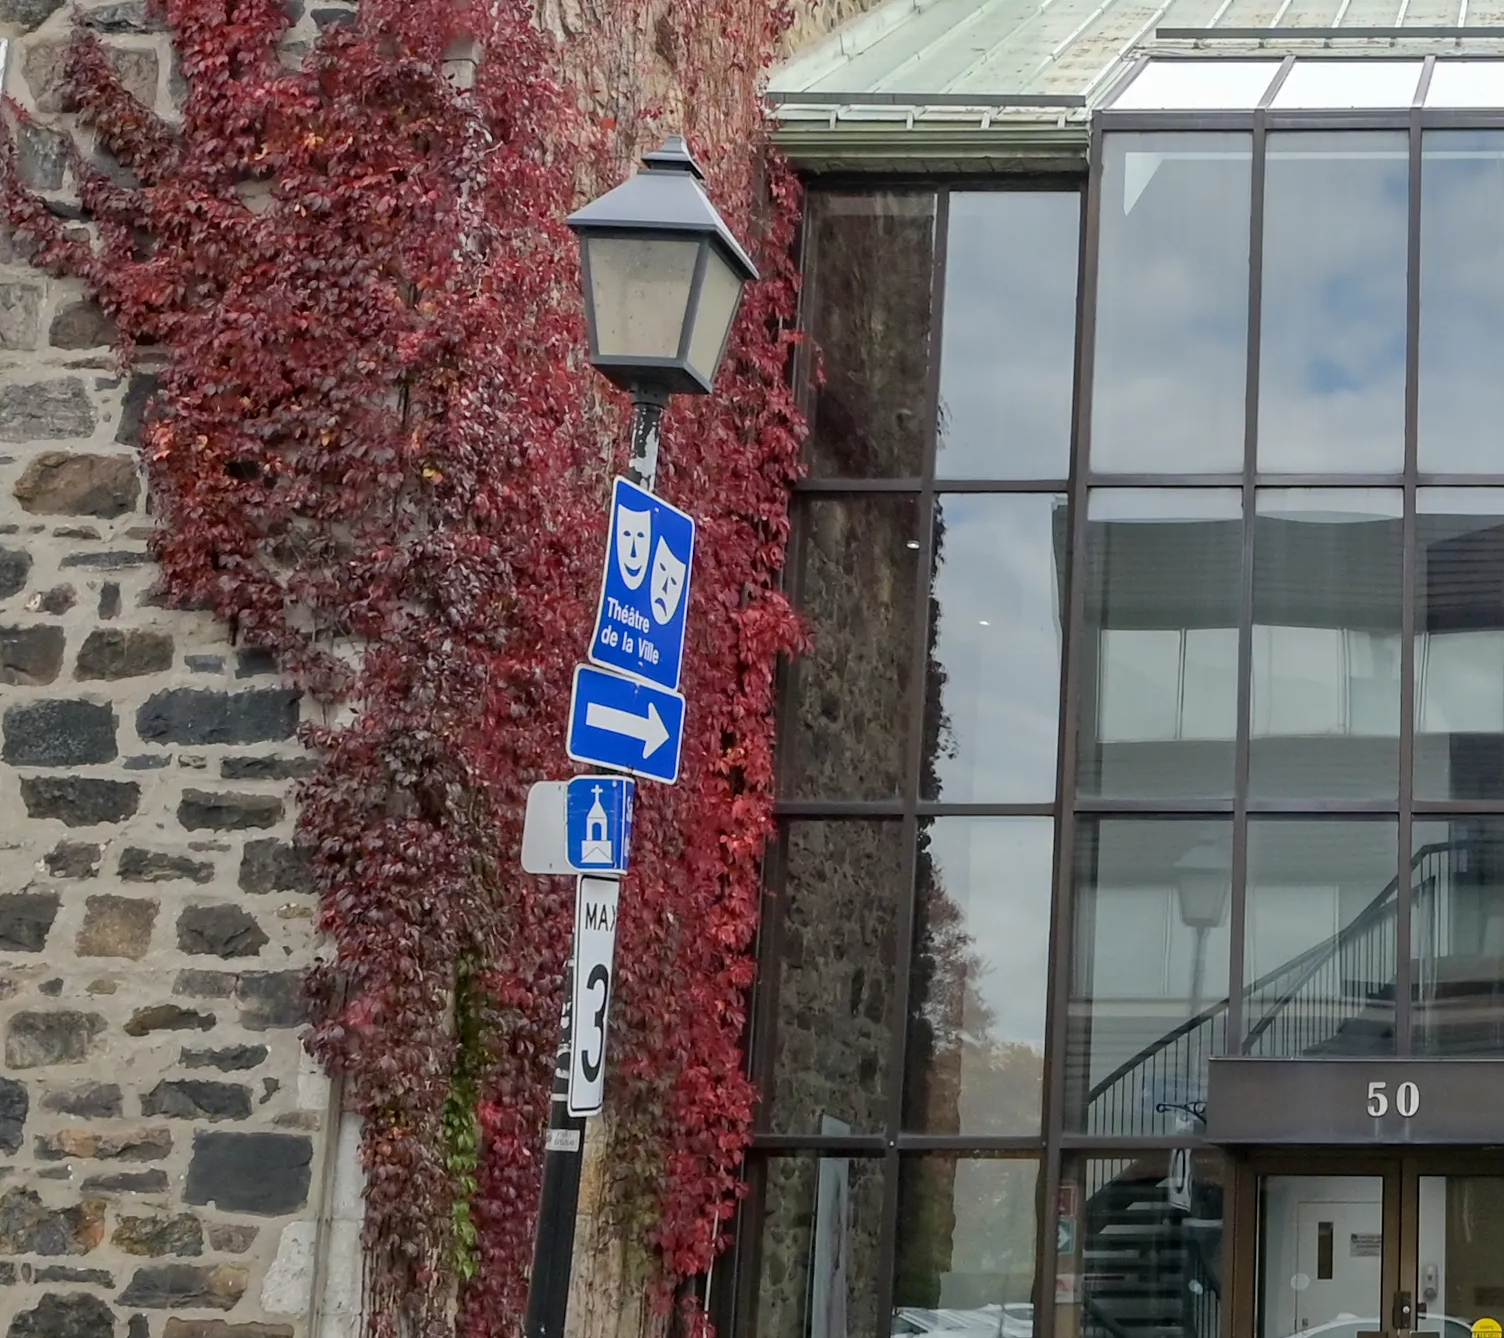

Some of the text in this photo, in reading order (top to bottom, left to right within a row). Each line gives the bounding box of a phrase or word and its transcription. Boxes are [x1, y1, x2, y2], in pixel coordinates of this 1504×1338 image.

[607, 596, 650, 634] Théâtre
[600, 624, 660, 665] de la Ville
[1367, 1081, 1420, 1117] 50
